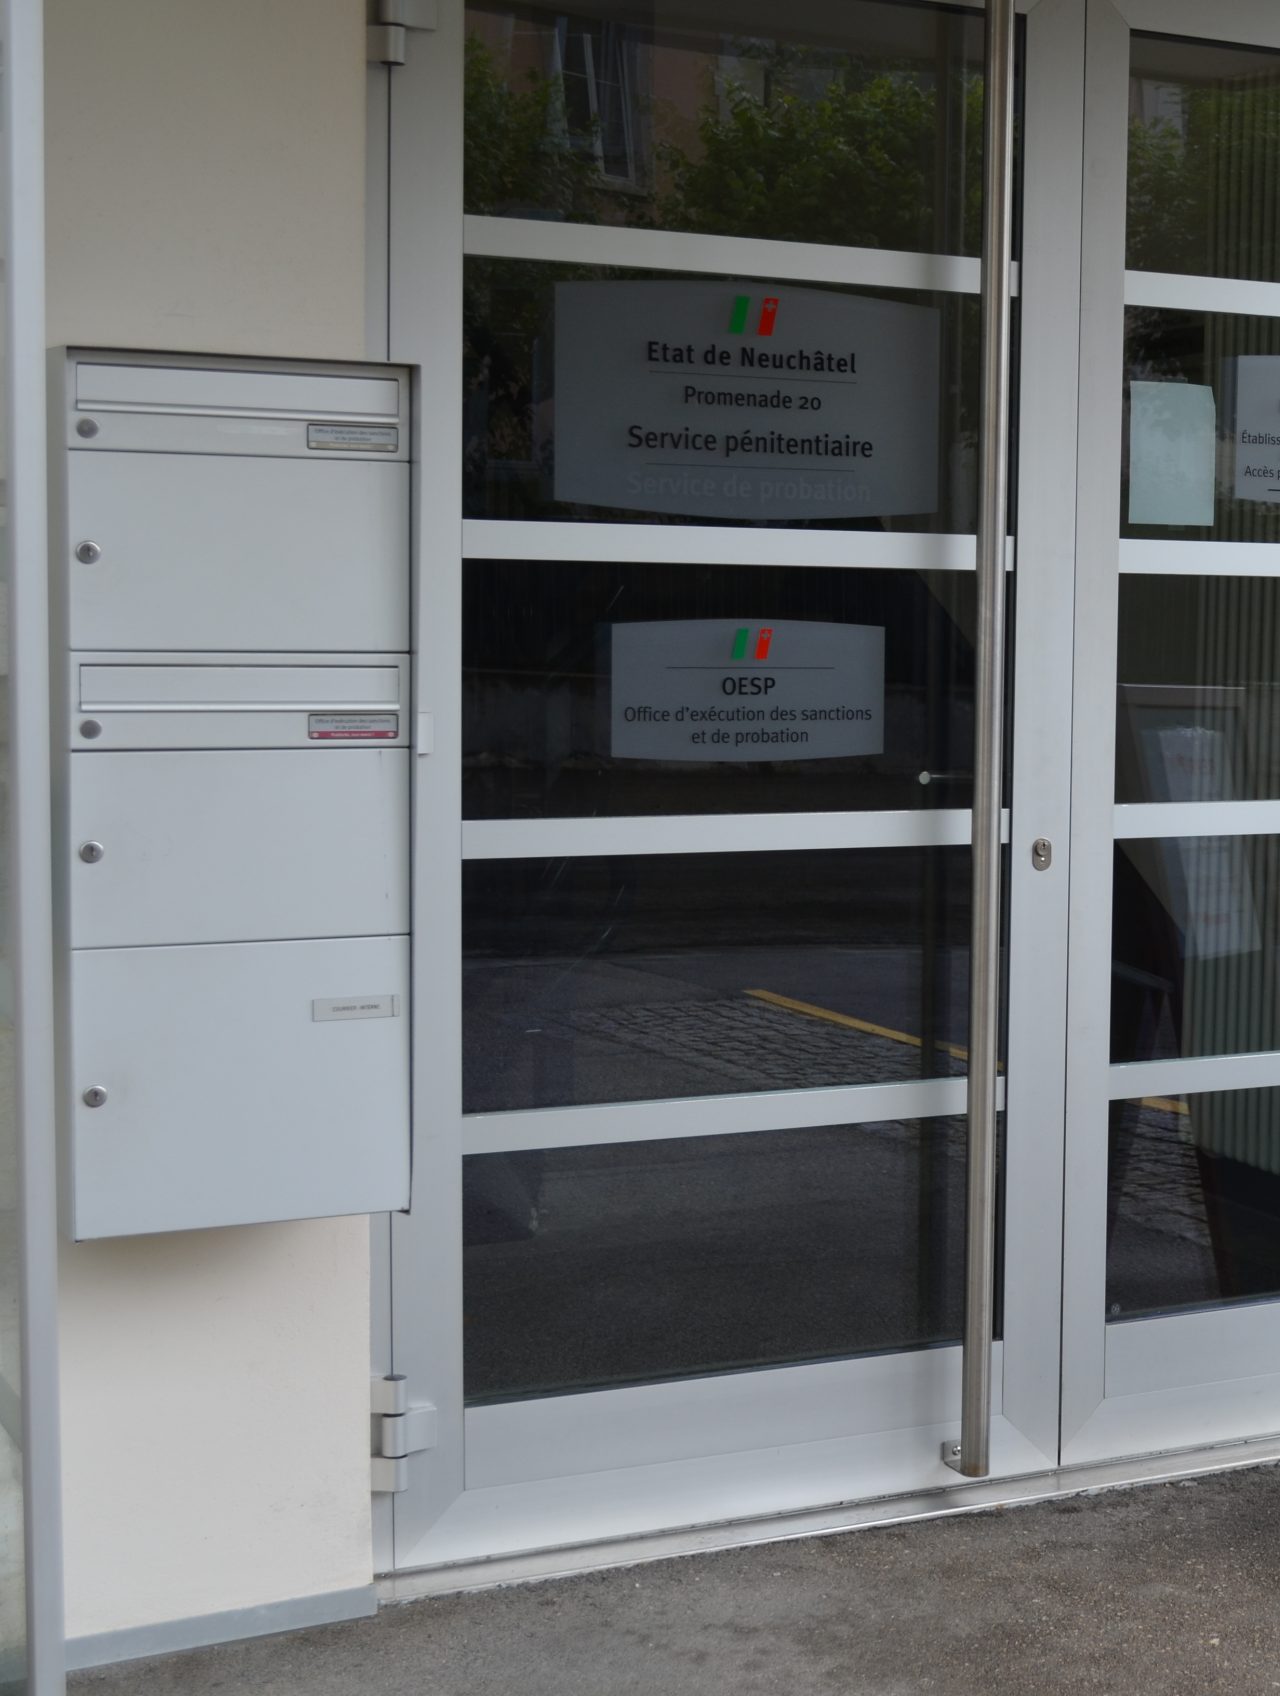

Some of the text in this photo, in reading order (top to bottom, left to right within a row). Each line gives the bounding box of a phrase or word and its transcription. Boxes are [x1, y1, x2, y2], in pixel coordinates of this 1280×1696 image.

[647, 340, 857, 374] Etat de Neuchâtel
[683, 384, 822, 411] Promenade 20
[627, 424, 874, 458] Service pénitentiaire
[1244, 465, 1274, 479] Accès
[626, 472, 871, 503] Service de probation
[721, 676, 776, 695] OESP
[624, 705, 872, 722] Office d'exécution des sanctions
[691, 728, 809, 747] et de probation
